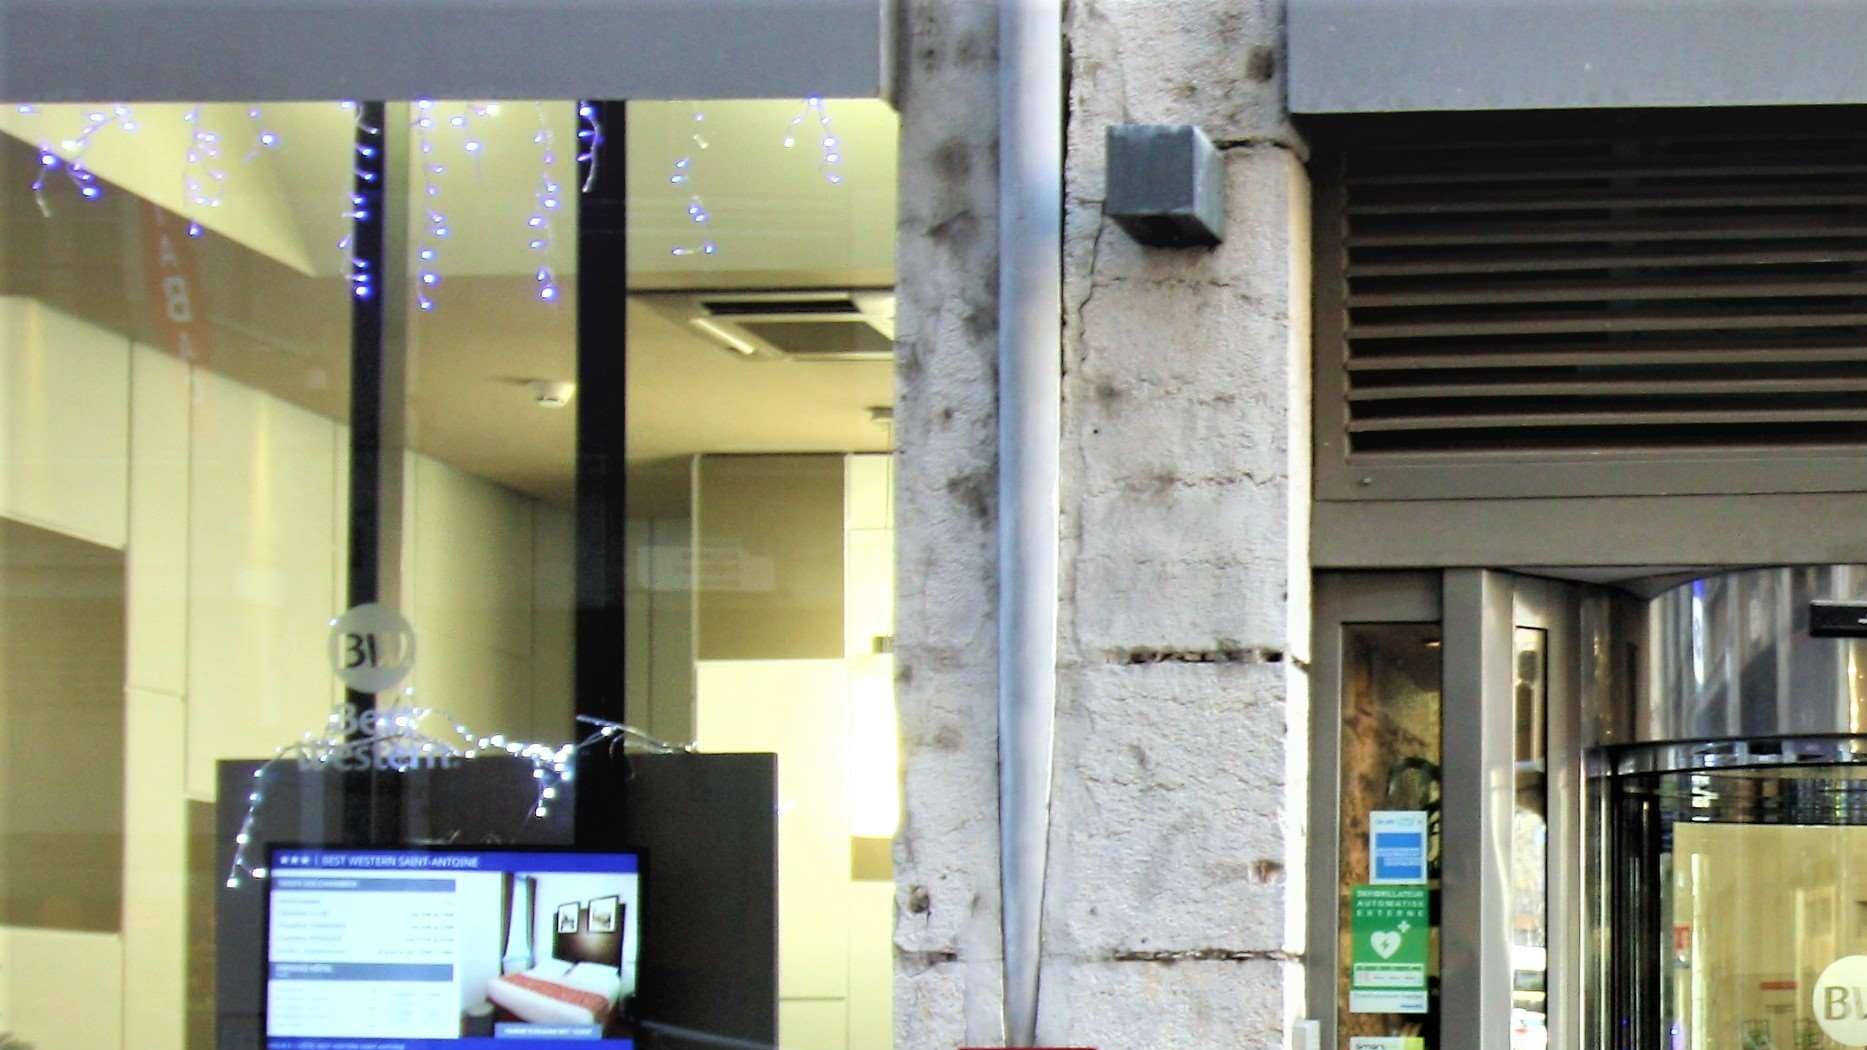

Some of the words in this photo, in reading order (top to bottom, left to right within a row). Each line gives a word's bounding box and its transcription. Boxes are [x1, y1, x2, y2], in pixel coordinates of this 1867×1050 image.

[321, 855, 346, 867] BEST
[348, 855, 397, 868] WESTERN
[398, 857, 479, 869] SAINT-ANTOINE
